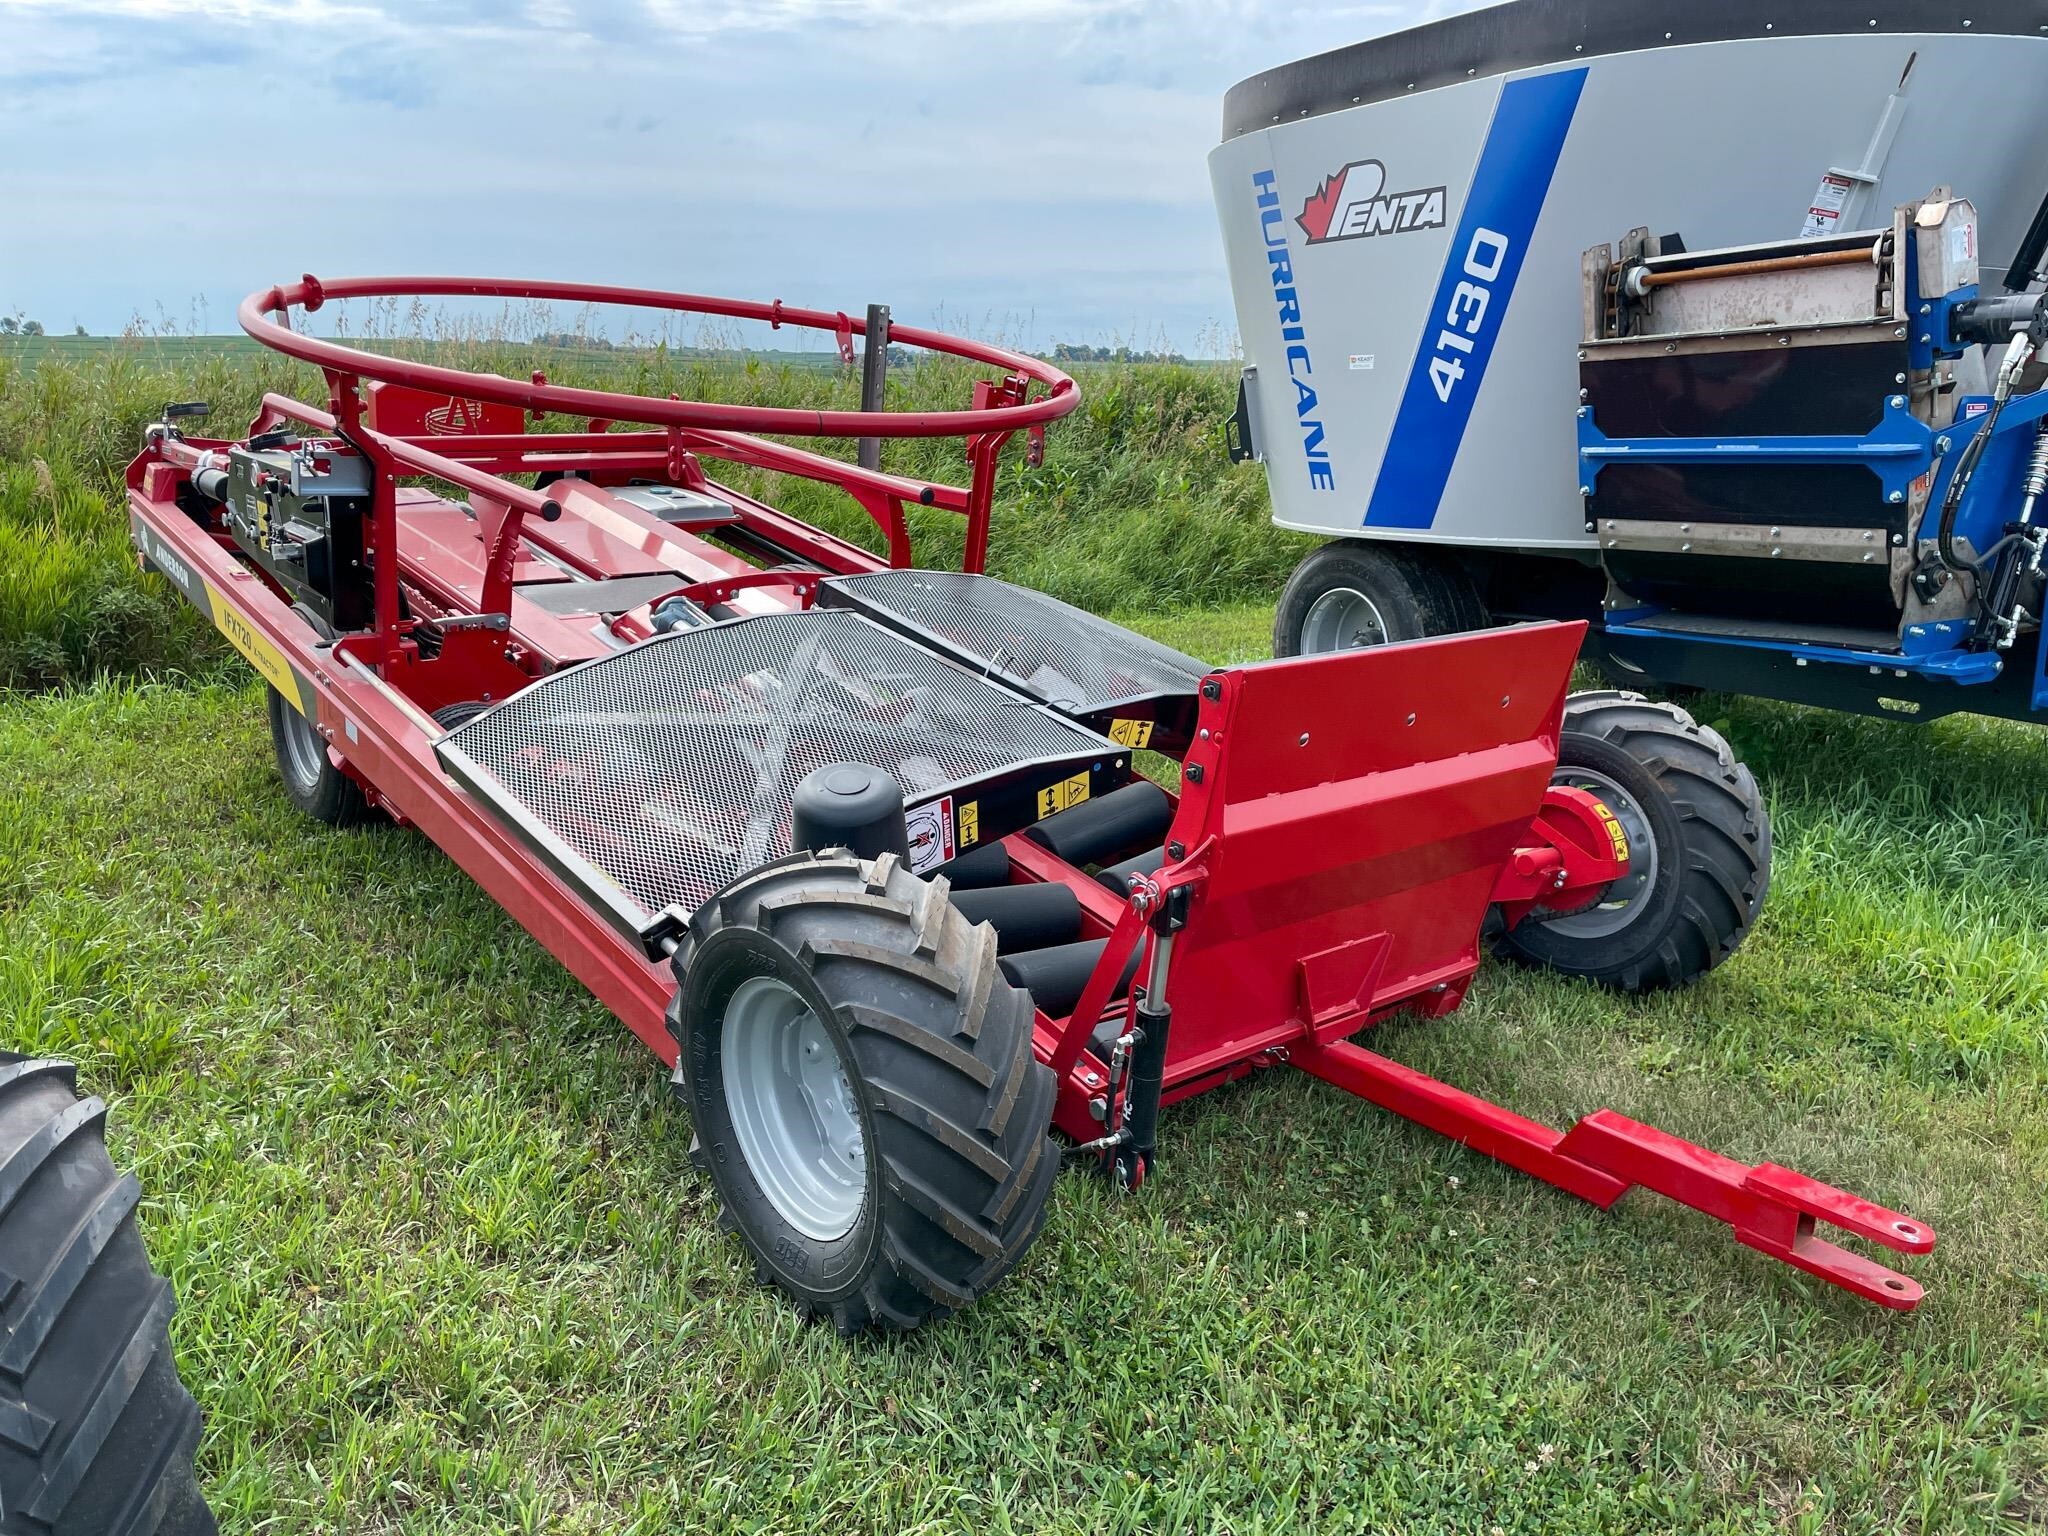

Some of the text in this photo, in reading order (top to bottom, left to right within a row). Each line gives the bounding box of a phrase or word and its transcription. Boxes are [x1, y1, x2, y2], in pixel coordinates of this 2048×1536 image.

[1325, 160, 1445, 239] PENTA
[1252, 169, 1335, 491] HURRICANE
[1428, 227, 1509, 403] 4130
[155, 543, 190, 589] ANDERSON
[223, 609, 252, 650] IFX720
[943, 819, 952, 849] DANGER
